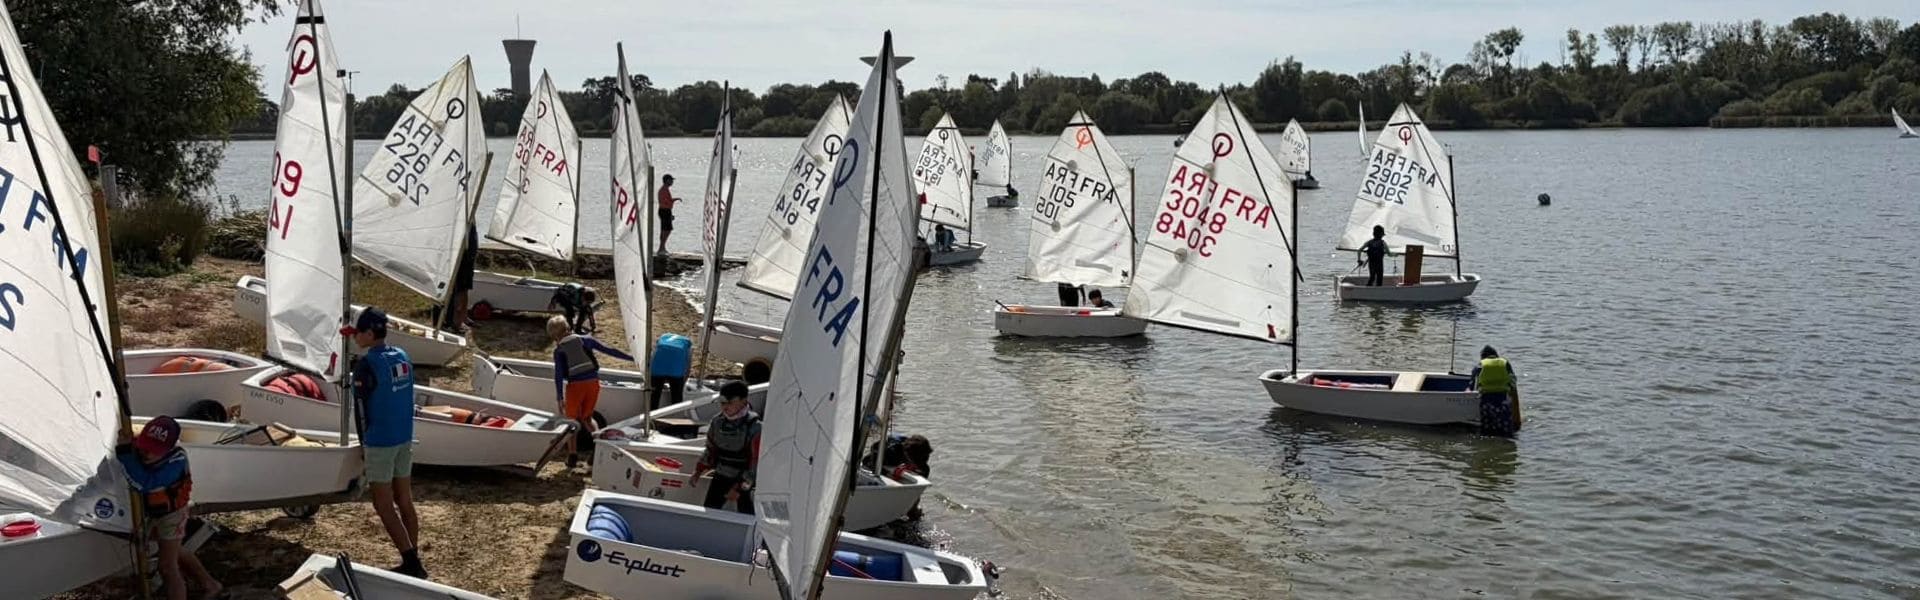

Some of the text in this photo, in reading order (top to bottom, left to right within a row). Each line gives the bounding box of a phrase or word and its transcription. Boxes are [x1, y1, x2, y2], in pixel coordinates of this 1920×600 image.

[385, 132, 430, 174] 226
[533, 143, 567, 177] FRA
[919, 155, 946, 175] 1976
[442, 148, 472, 192] FRA
[1368, 165, 1412, 190] 2902
[1407, 161, 1437, 188] FRA
[793, 183, 820, 215] 614
[1049, 184, 1077, 208] 105
[1080, 177, 1115, 204] FRA
[1166, 189, 1227, 234] 3048
[1219, 188, 1272, 229] FRA
[805, 244, 861, 348] FRA
[148, 425, 169, 442] FRA
